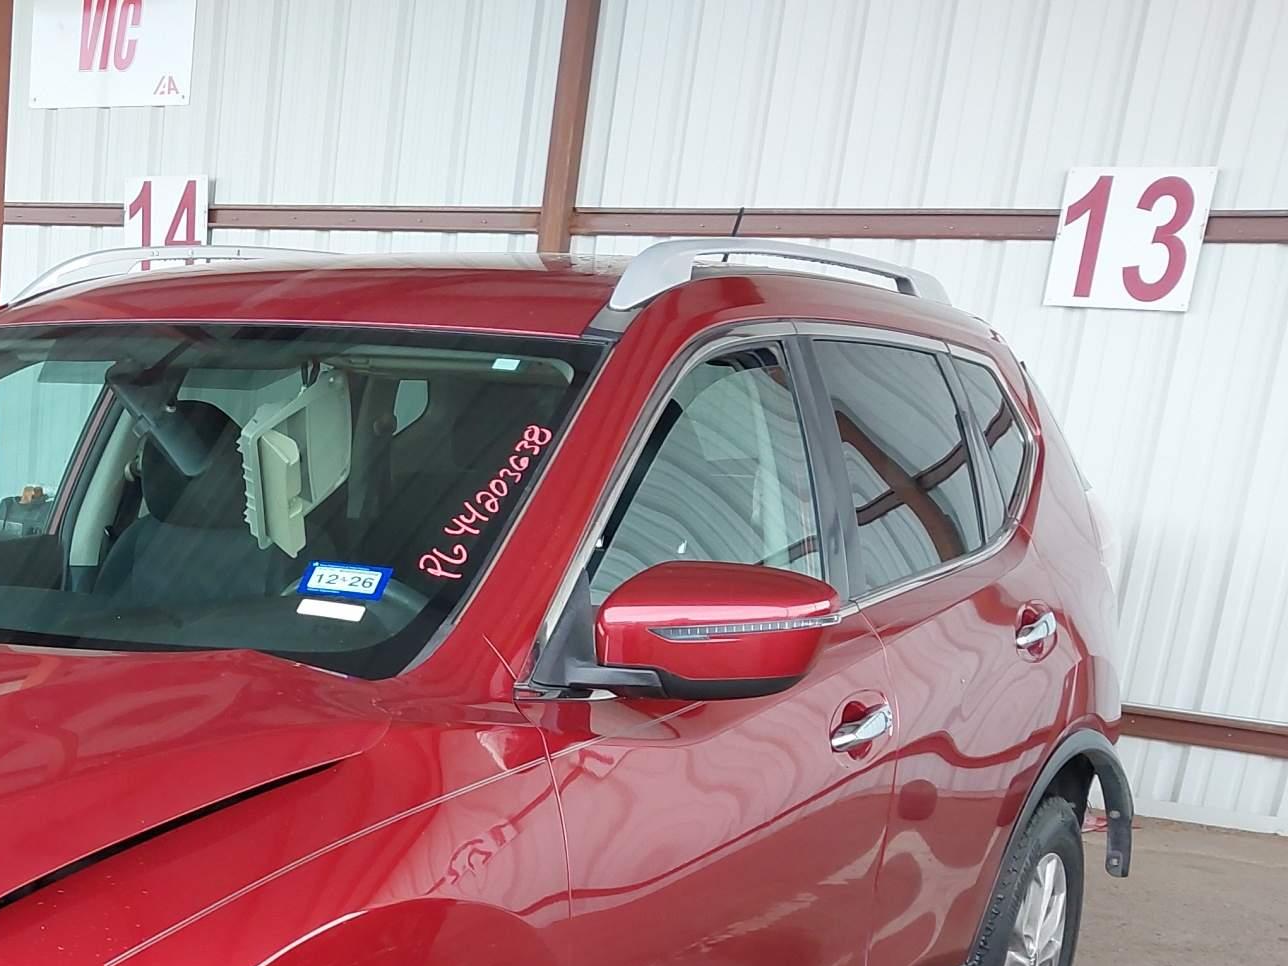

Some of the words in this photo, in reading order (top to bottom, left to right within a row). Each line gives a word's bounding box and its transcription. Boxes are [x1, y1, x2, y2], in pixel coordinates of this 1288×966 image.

[79, 0, 143, 72] VIC
[129, 180, 202, 271] 14
[1064, 175, 1195, 302] 13
[444, 424, 553, 536] 44203638
